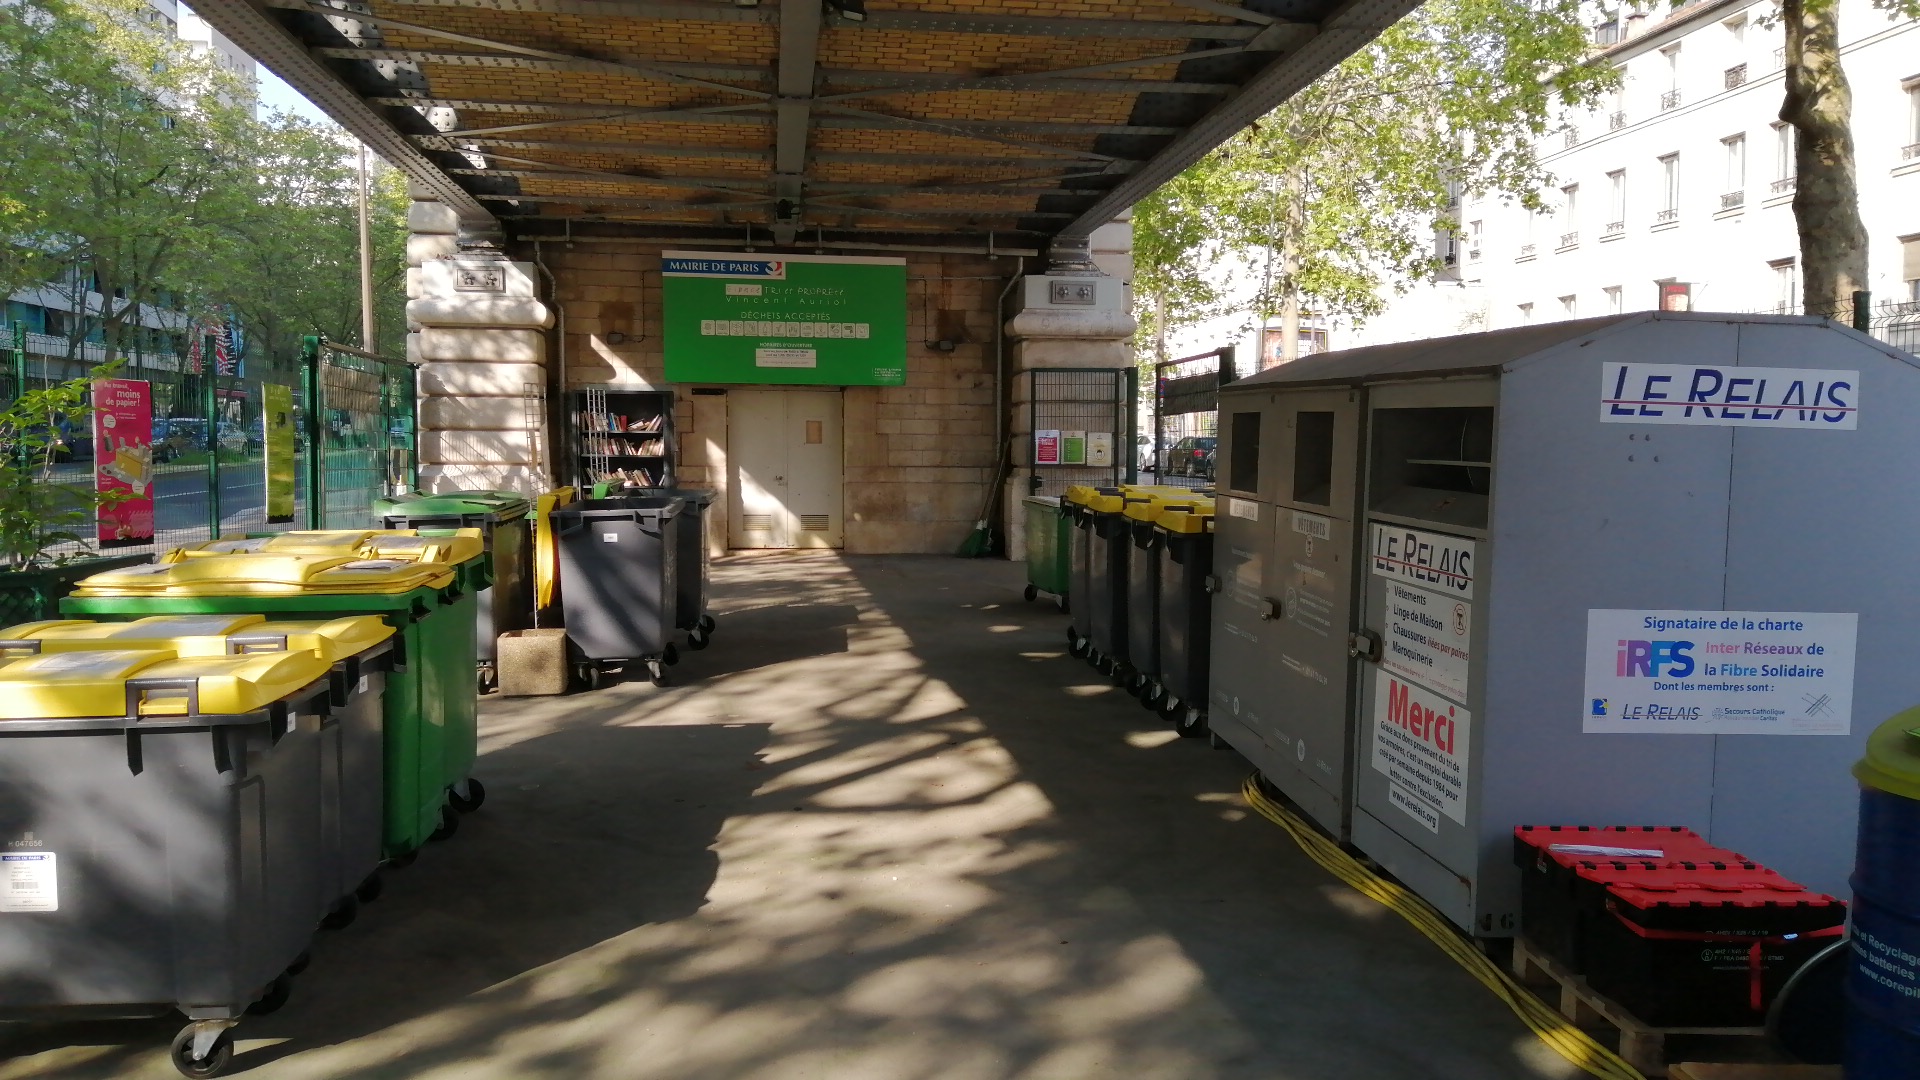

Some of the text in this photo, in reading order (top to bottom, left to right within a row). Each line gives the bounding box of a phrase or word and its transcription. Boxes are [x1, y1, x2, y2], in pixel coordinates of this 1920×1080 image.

[669, 261, 760, 273] MAIRIE DE PARIS
[725, 296, 847, 306] Vincent Auriol
[740, 310, 831, 321] DÉCHETS ACCEPTÉS
[105, 397, 114, 406] de
[116, 389, 141, 399] moins
[1609, 366, 1851, 423] LE RELAIS
[1297, 516, 1327, 537] VÊTEMENTS
[1376, 528, 1471, 591] LE RELAIS
[1393, 585, 1427, 606] Vêtements
[1393, 603, 1443, 632] Linge de Maison
[1643, 616, 1804, 632] Signataire de la charte
[1392, 622, 1469, 661] Chaussures liées par paires
[1705, 641, 1825, 656] Inter Réseaux de
[1391, 640, 1433, 668] Maroquinerie
[1616, 639, 1695, 678] iRFS
[1704, 663, 1825, 678] la Fibre Solidaire
[1653, 682, 1679, 691] Dont
[1681, 682, 1695, 692] les
[1697, 682, 1745, 693] membres
[1746, 684, 1770, 692] sont
[1388, 678, 1455, 756] Merci
[1622, 703, 1701, 721] LE RELAIS
[1724, 707, 1785, 717] Secours Catholique
[1380, 720, 1393, 735] Grâce
[1393, 728, 1402, 740] aux
[1401, 731, 1413, 745] dons
[1413, 741, 1438, 762] provenant
[1438, 752, 1446, 765] du
[1452, 760, 1460, 773] de
[1377, 733, 1462, 789] vos armoires, c'est un emploi durable
[1378, 747, 1388, 760] créé
[1388, 753, 1397, 766] par
[1396, 757, 1416, 777] semaine
[1415, 766, 1433, 786] depuis
[1445, 787, 1459, 802] pour
[1389, 766, 1444, 809] lutter contre l'exclusion.
[1391, 788, 1437, 829] www.lerelais.org
[1860, 931, 1867, 942] et
[1868, 951, 1916, 981] batteries
